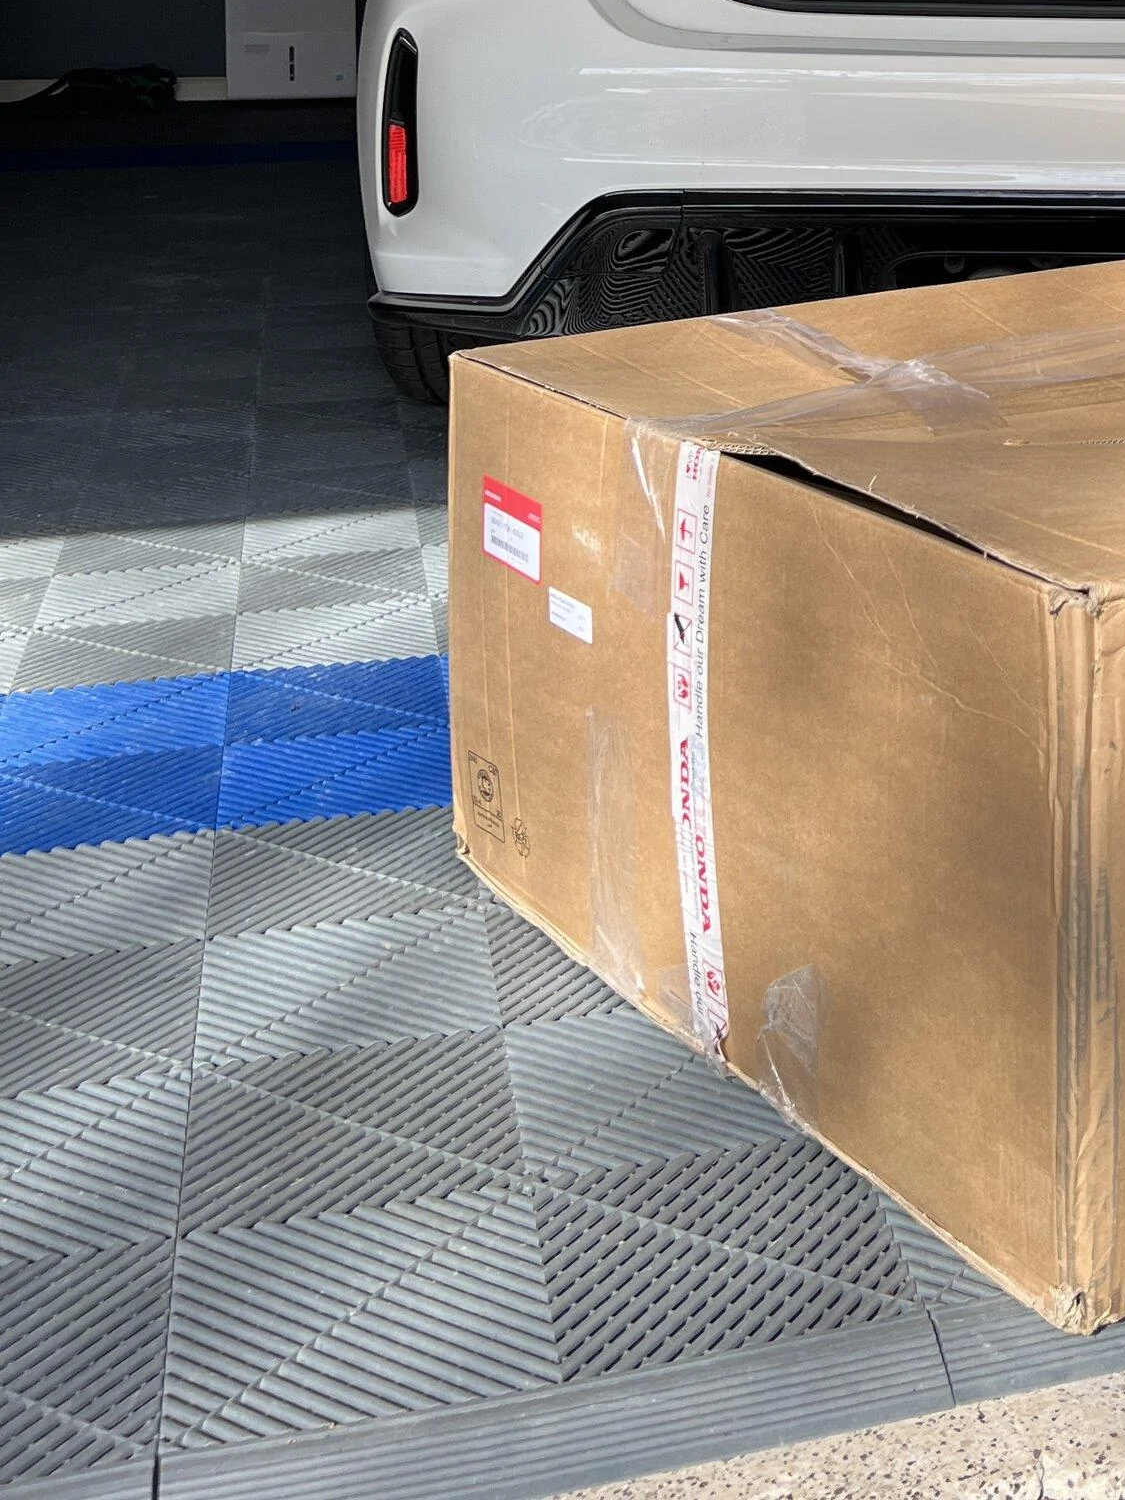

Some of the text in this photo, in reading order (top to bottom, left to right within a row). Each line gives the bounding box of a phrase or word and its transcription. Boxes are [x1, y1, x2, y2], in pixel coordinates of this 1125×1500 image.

[699, 504, 711, 544] Care
[697, 551, 708, 583] with
[694, 589, 706, 643] Dream
[695, 648, 705, 675] our
[694, 681, 705, 738] Handle
[695, 834, 712, 934] ONDA
[689, 932, 702, 987] Handle
[695, 991, 704, 1017] our
